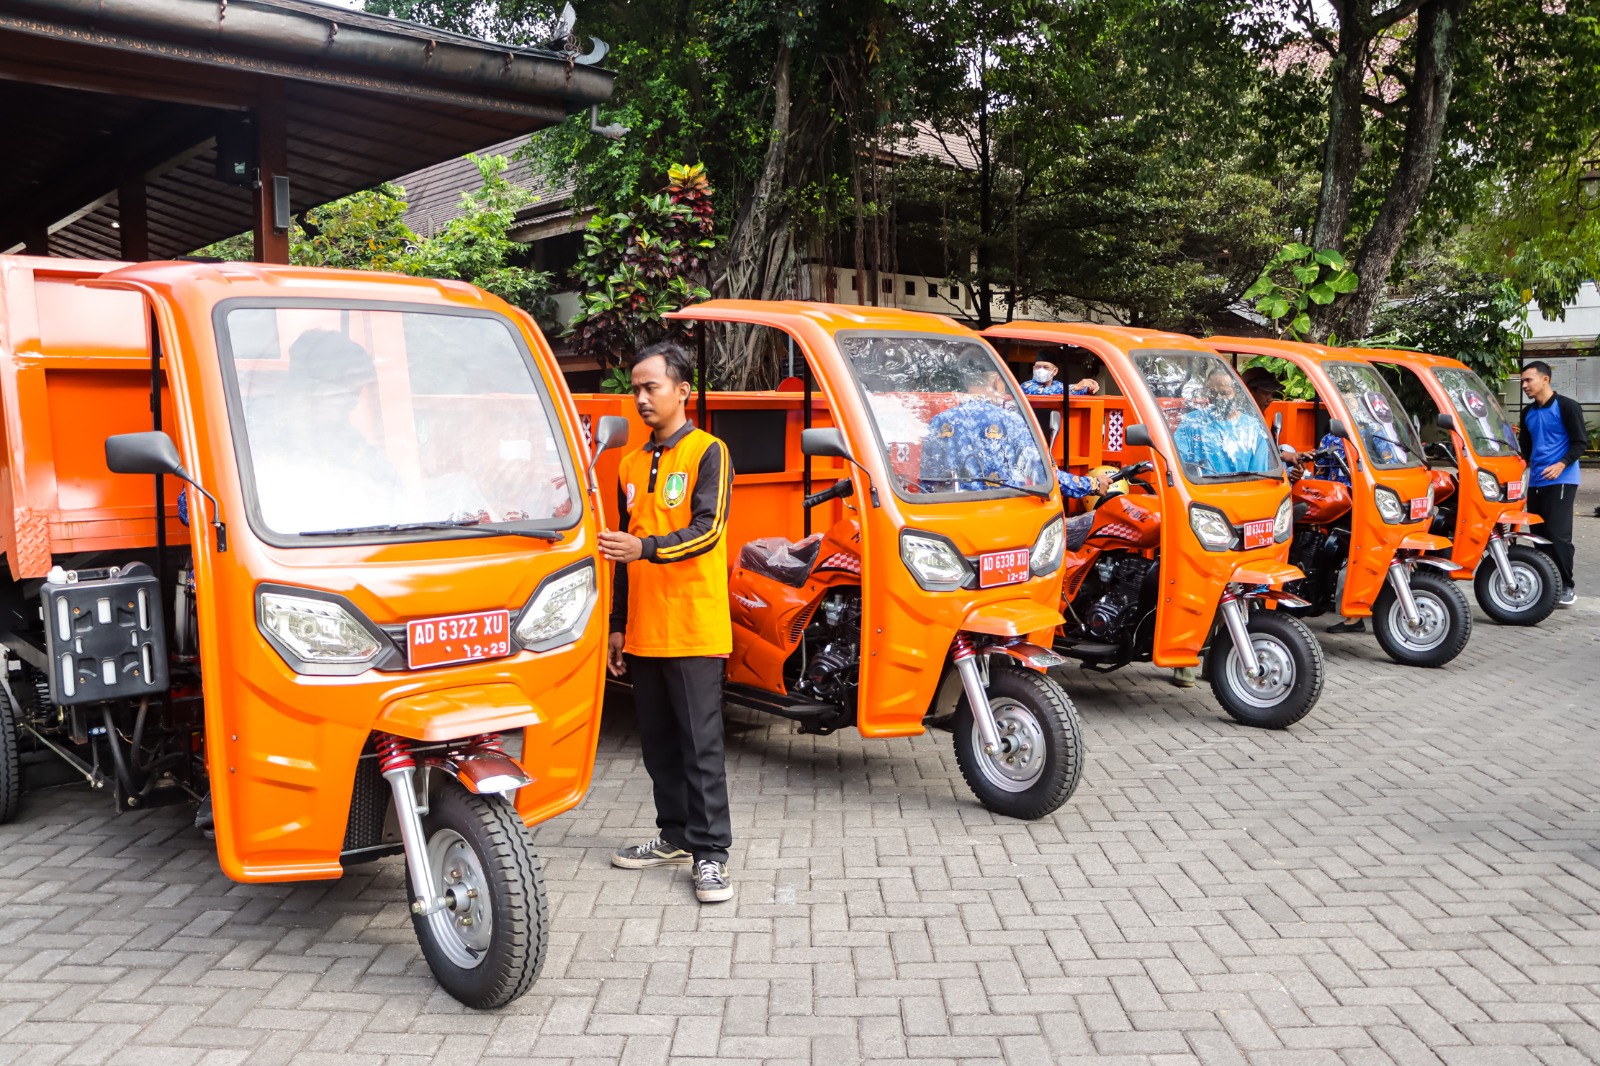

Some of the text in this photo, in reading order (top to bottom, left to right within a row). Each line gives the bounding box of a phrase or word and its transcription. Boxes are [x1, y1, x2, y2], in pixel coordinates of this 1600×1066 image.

[984, 552, 1026, 571] AD 6338 XU
[415, 615, 502, 645] AD 6322 XU
